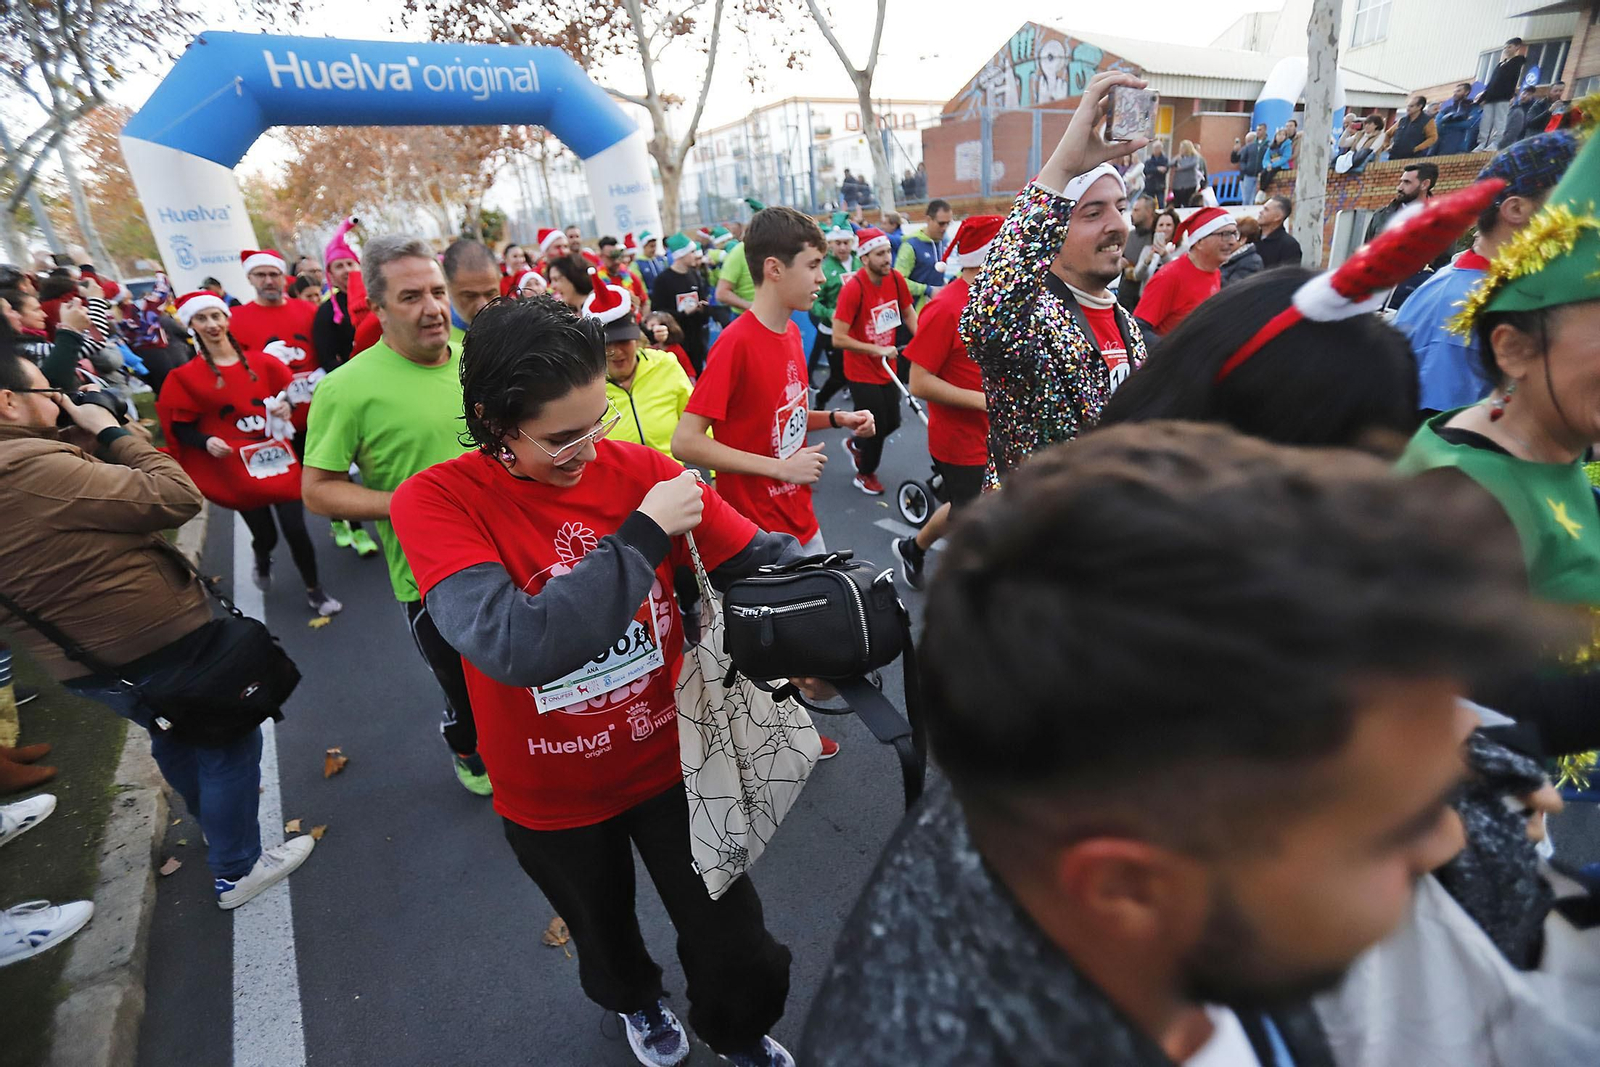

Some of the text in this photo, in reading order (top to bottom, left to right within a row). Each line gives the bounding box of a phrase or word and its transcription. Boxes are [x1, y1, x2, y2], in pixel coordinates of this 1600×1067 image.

[262, 49, 541, 101] Huelva original
[157, 204, 232, 223] Huelva
[586, 666, 600, 675] ANA
[527, 725, 615, 755] Huelva
[584, 745, 613, 759] original
